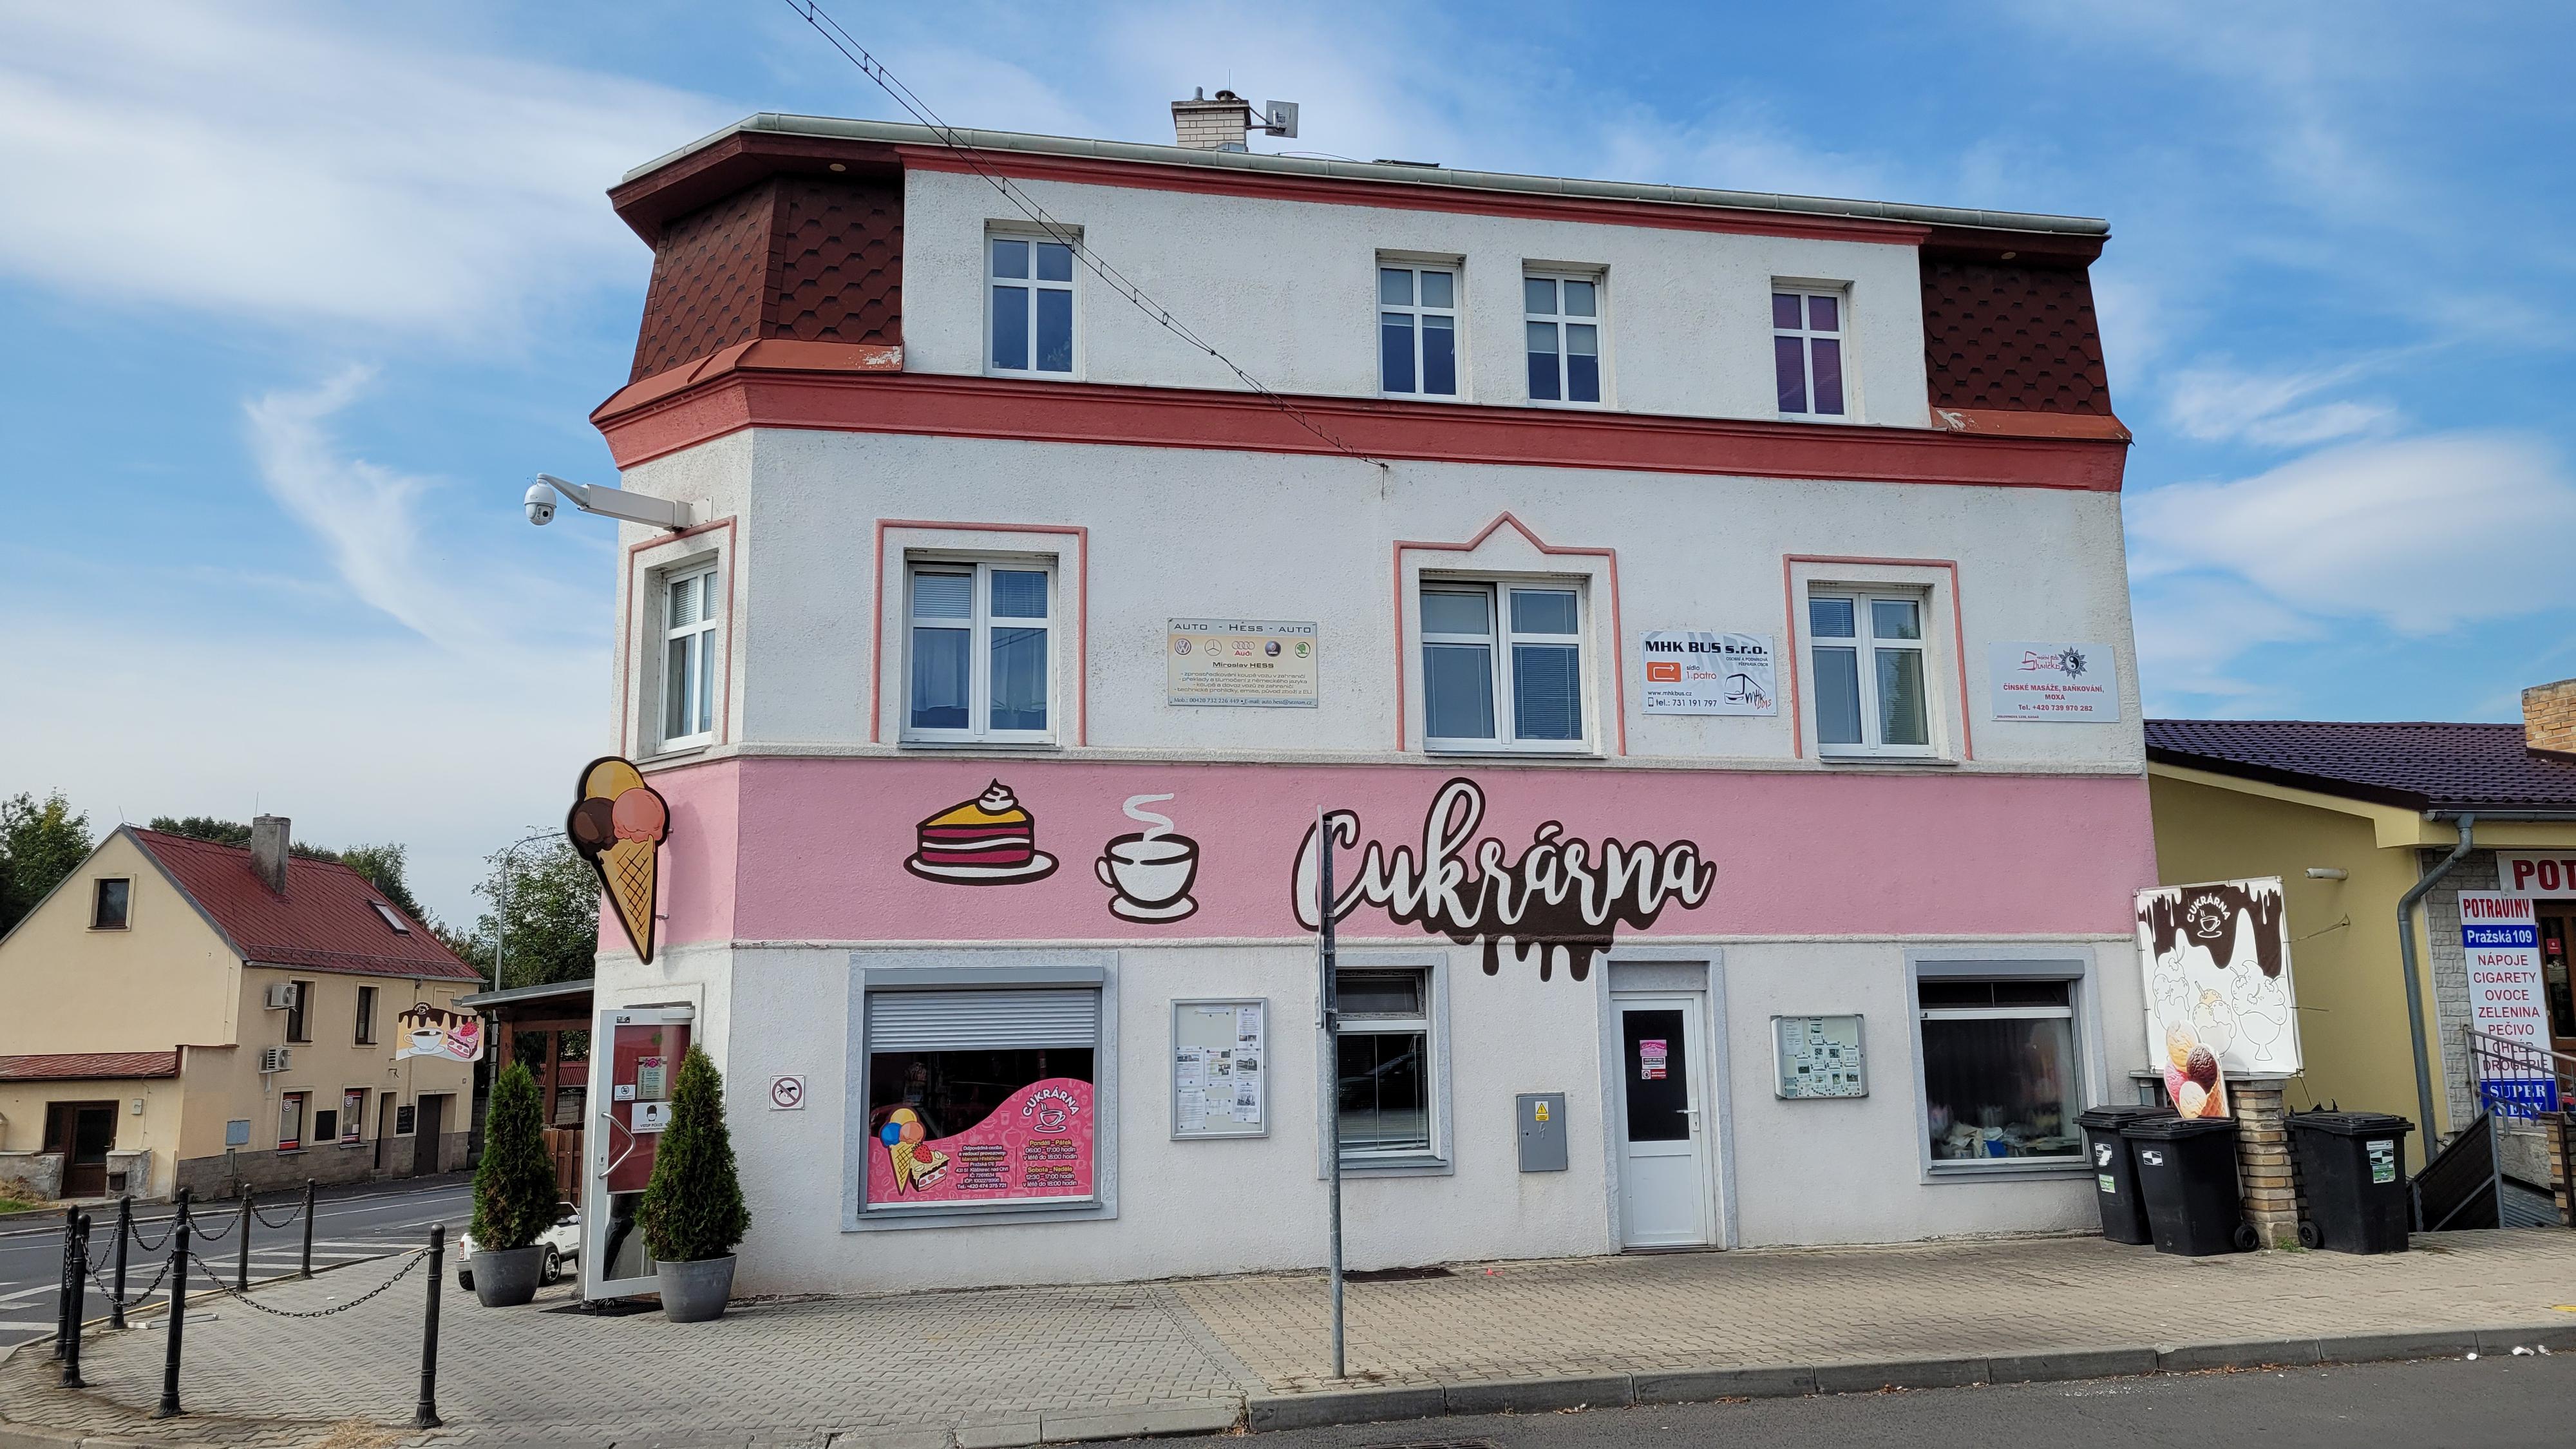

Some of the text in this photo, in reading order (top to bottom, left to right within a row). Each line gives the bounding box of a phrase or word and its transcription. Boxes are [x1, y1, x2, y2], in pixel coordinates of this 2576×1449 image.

[1645, 641, 1768, 654] MHK BUS s.r.o.
[2031, 683, 2061, 692] MASÁŽE,
[2063, 685, 2105, 694] BAŇKOVÁNÍ,
[1291, 777, 1718, 931] Cukrárna
[2186, 893, 2231, 923] CUKRÁRNA
[2463, 898, 2530, 918] POTRAVINY
[2467, 929, 2533, 943] Pražská 109
[2477, 952, 2529, 966] NÁPOJE
[2473, 972, 2537, 983] CIGARETY
[2485, 989, 2530, 1001] OVOCE
[2478, 1007, 2541, 1018] ZELENINA
[2488, 1021, 2535, 1036] PEČIVO
[2490, 1084, 2546, 1098] SUPER
[1023, 1086, 1080, 1116] CUKRÁRNA
